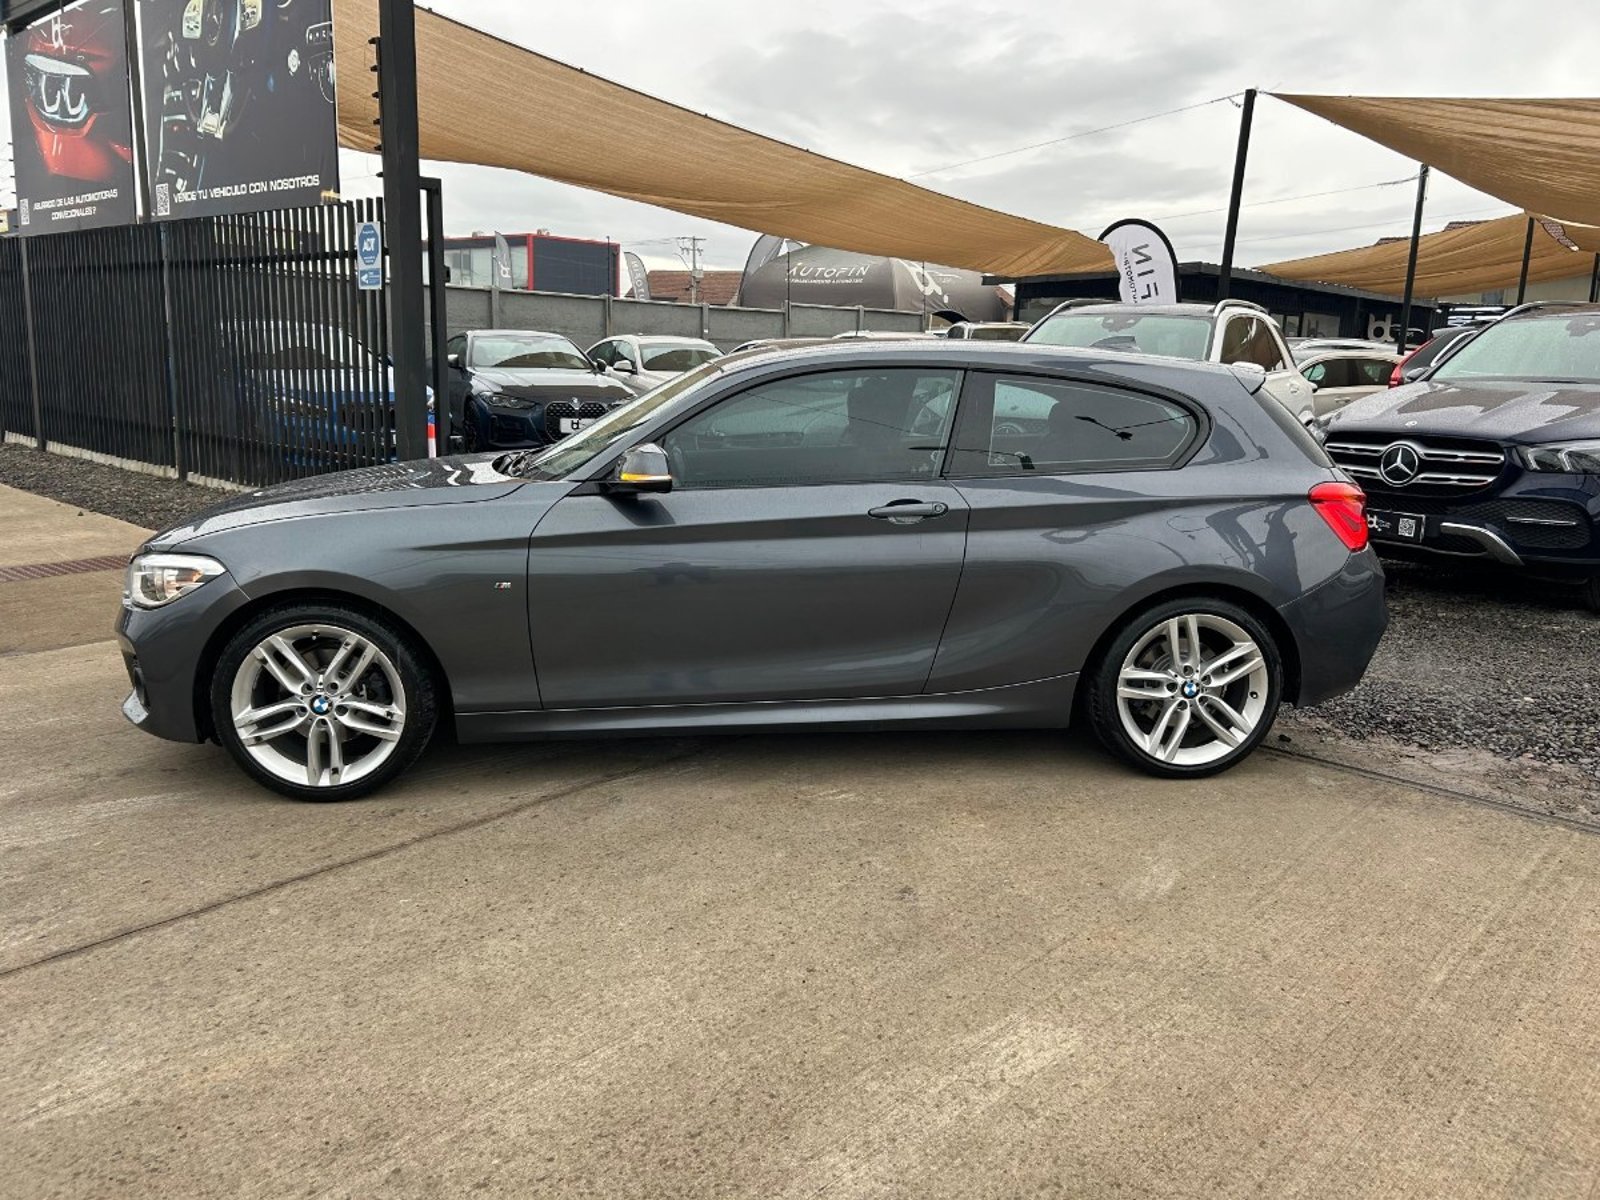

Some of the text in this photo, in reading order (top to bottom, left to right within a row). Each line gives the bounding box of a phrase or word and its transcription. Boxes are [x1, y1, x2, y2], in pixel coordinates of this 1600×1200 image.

[64, 196, 74, 206] LAS
[75, 188, 118, 204] AUTOMOTORAS
[172, 174, 320, 204] VENDE TU VEHICULO CON NOSOTROS
